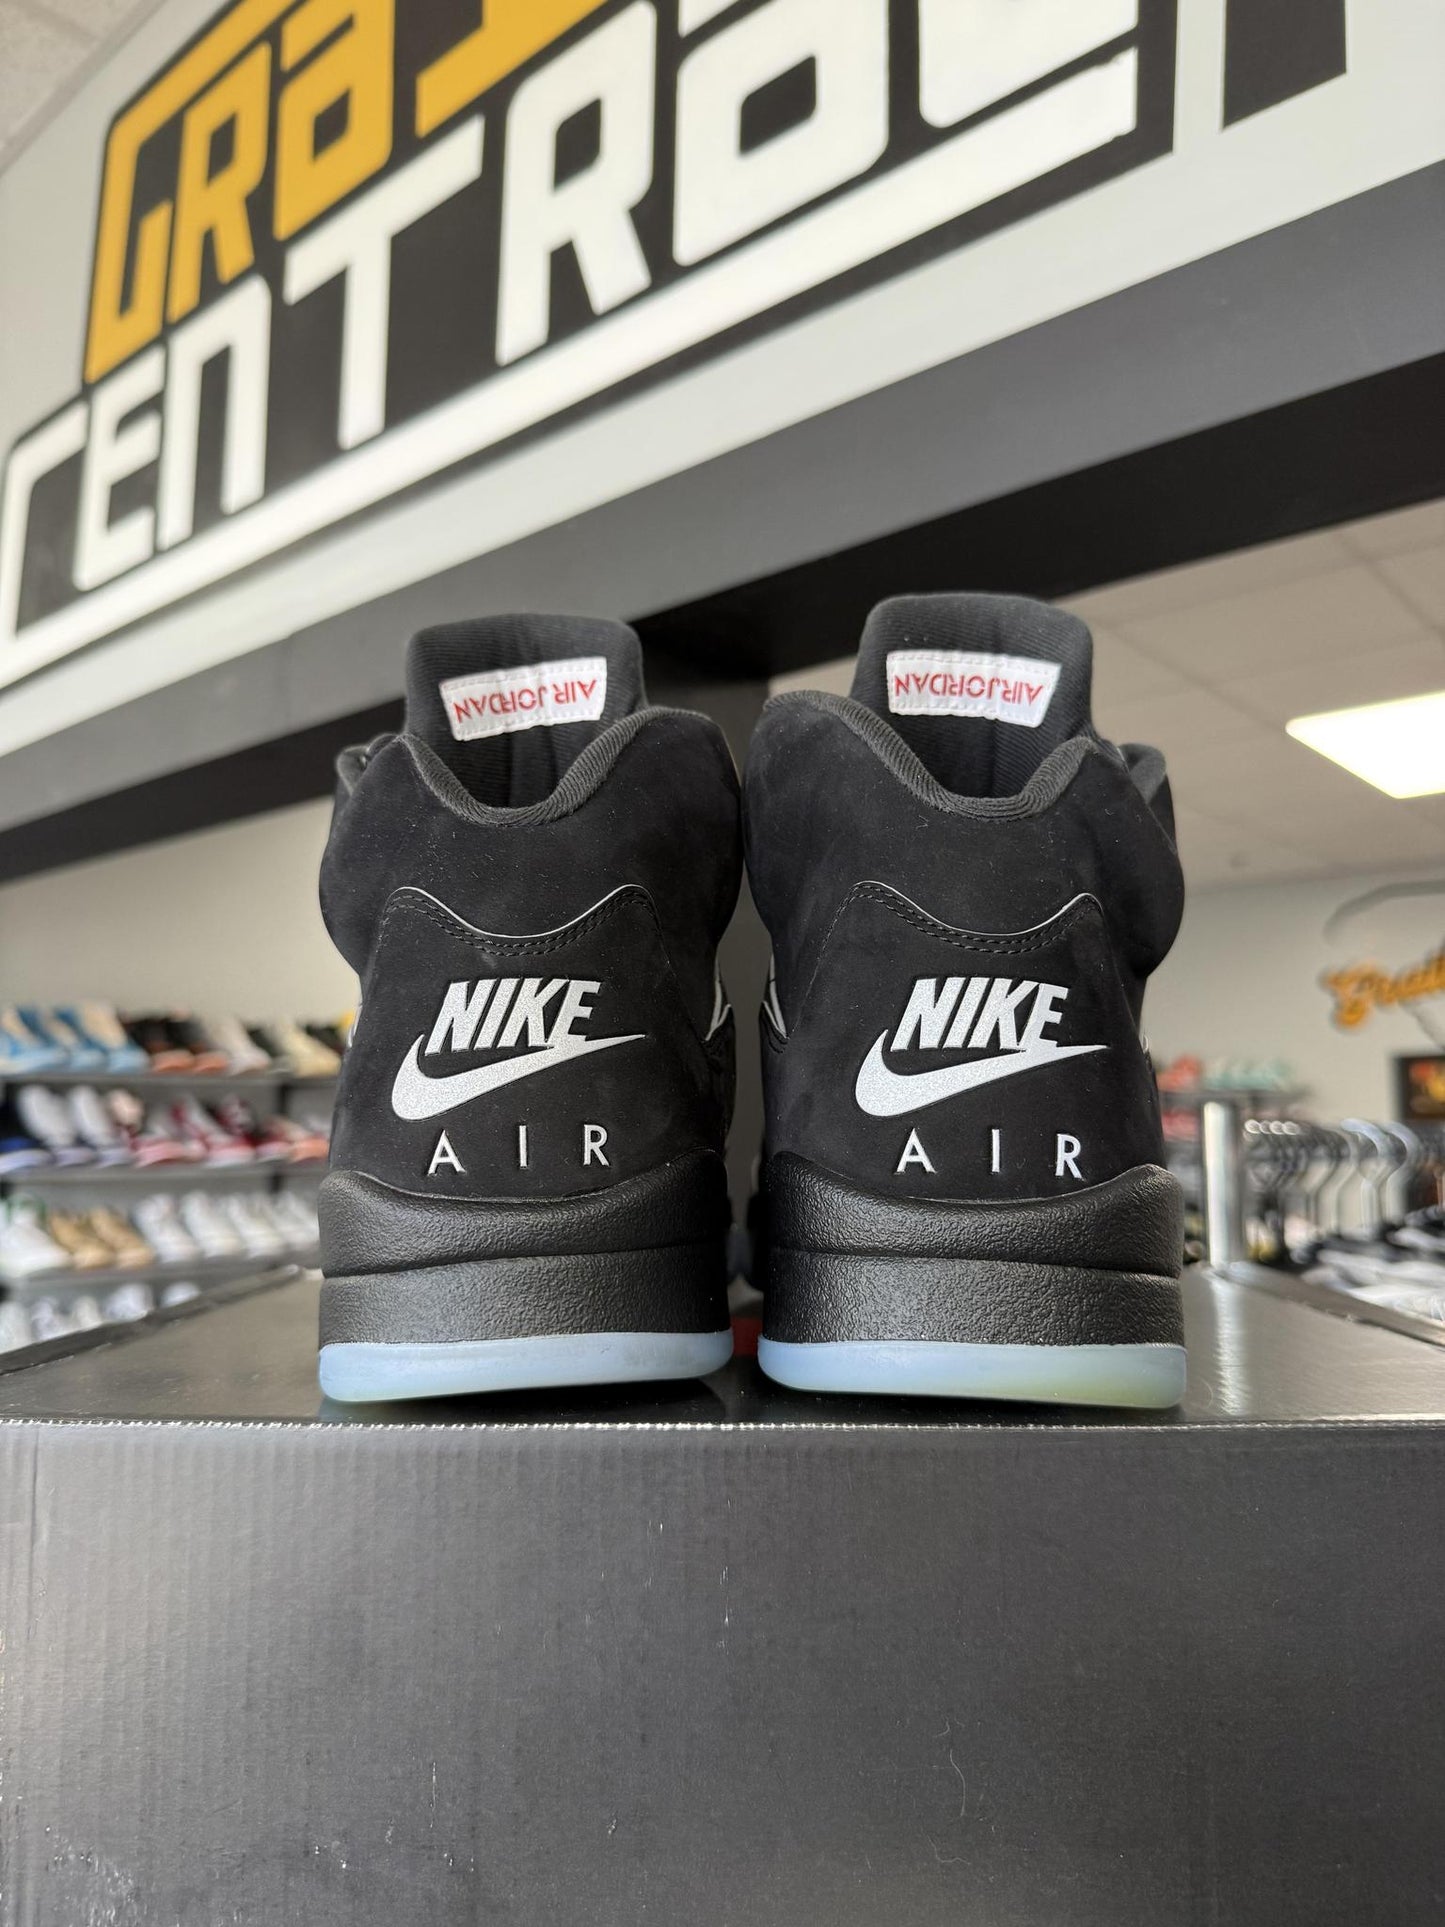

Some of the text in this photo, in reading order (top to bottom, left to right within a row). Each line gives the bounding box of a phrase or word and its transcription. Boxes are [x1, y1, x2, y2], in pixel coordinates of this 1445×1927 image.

[453, 679, 597, 723] AIR JORDAN
[894, 672, 1044, 706] AIR JORDAN
[425, 977, 601, 1056] NIKE
[891, 977, 1069, 1052] NIKE
